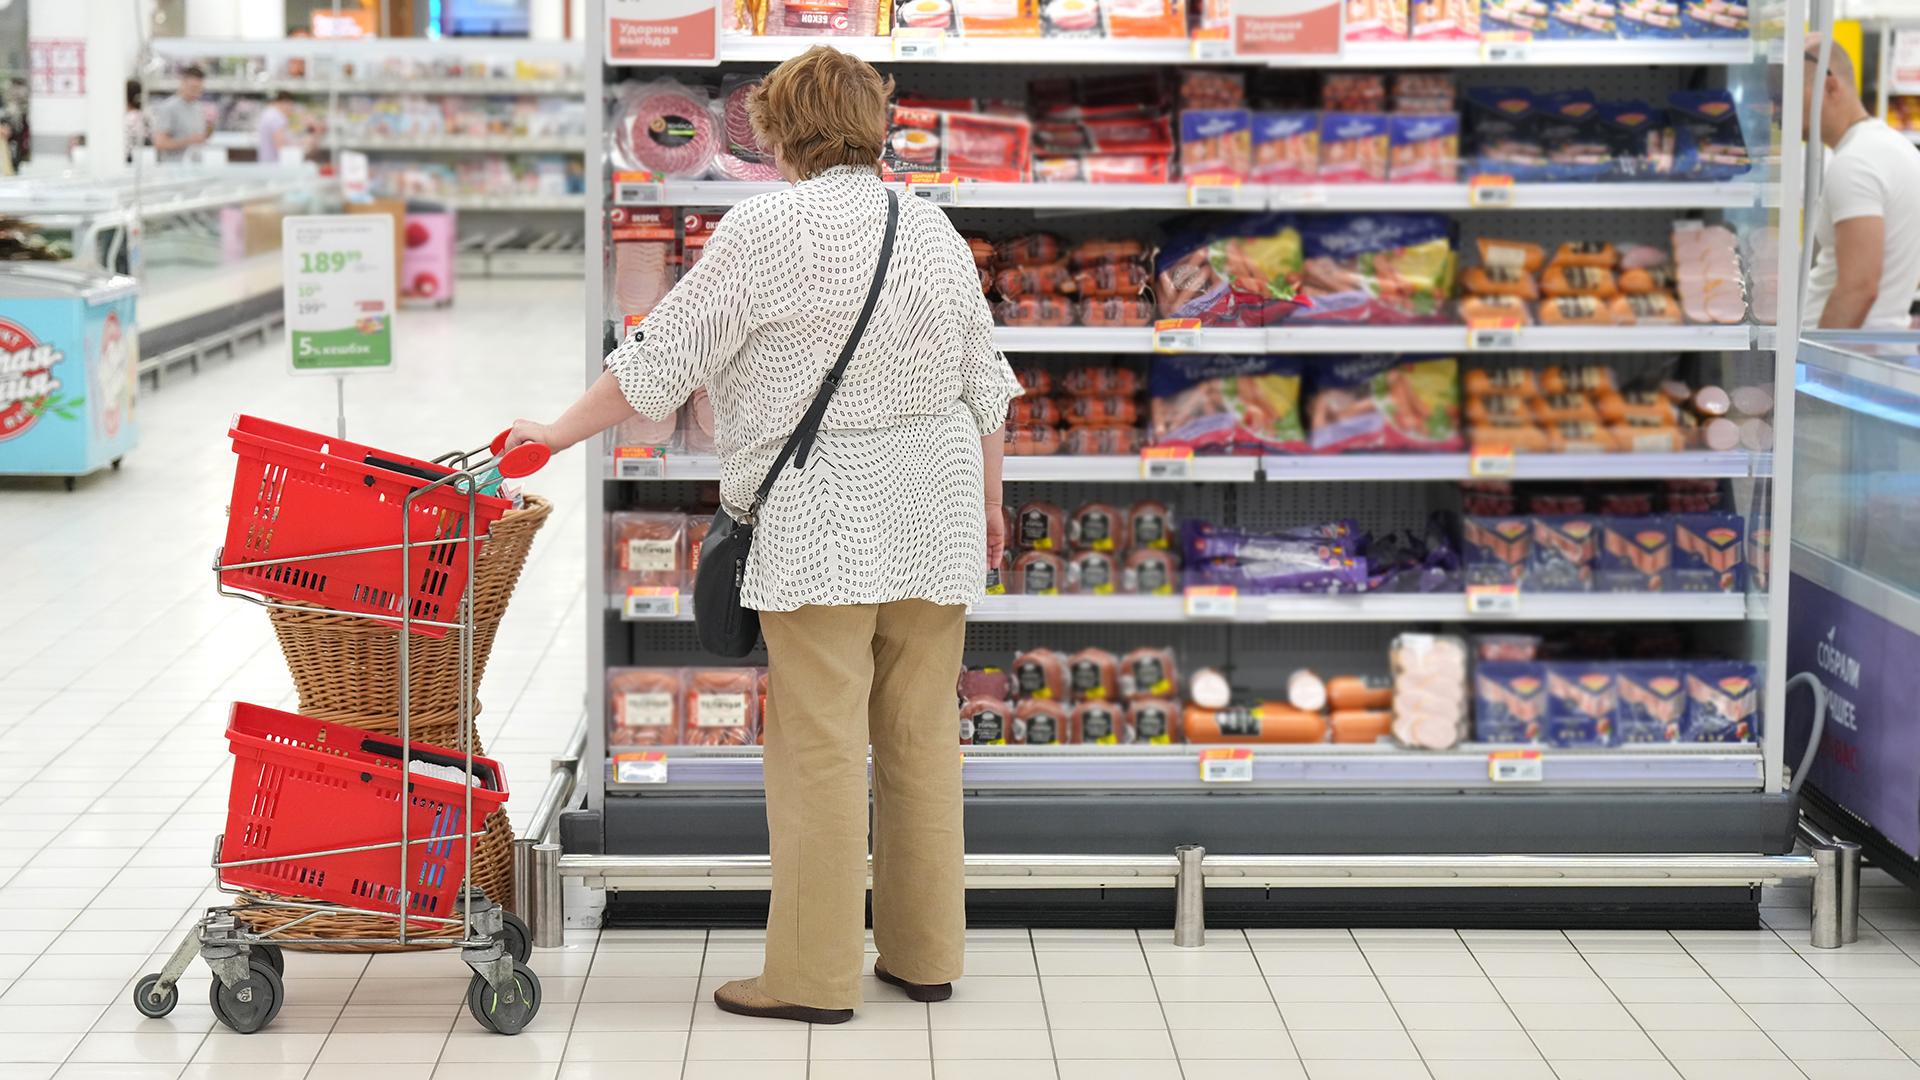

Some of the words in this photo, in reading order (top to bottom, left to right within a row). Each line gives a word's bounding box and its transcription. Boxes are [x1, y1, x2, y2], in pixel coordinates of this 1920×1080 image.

[801, 14, 828, 24] БЕКОН
[619, 23, 679, 36] Ударная
[619, 36, 671, 47] выгода
[1817, 641, 1861, 689] СОБРАЛИ
